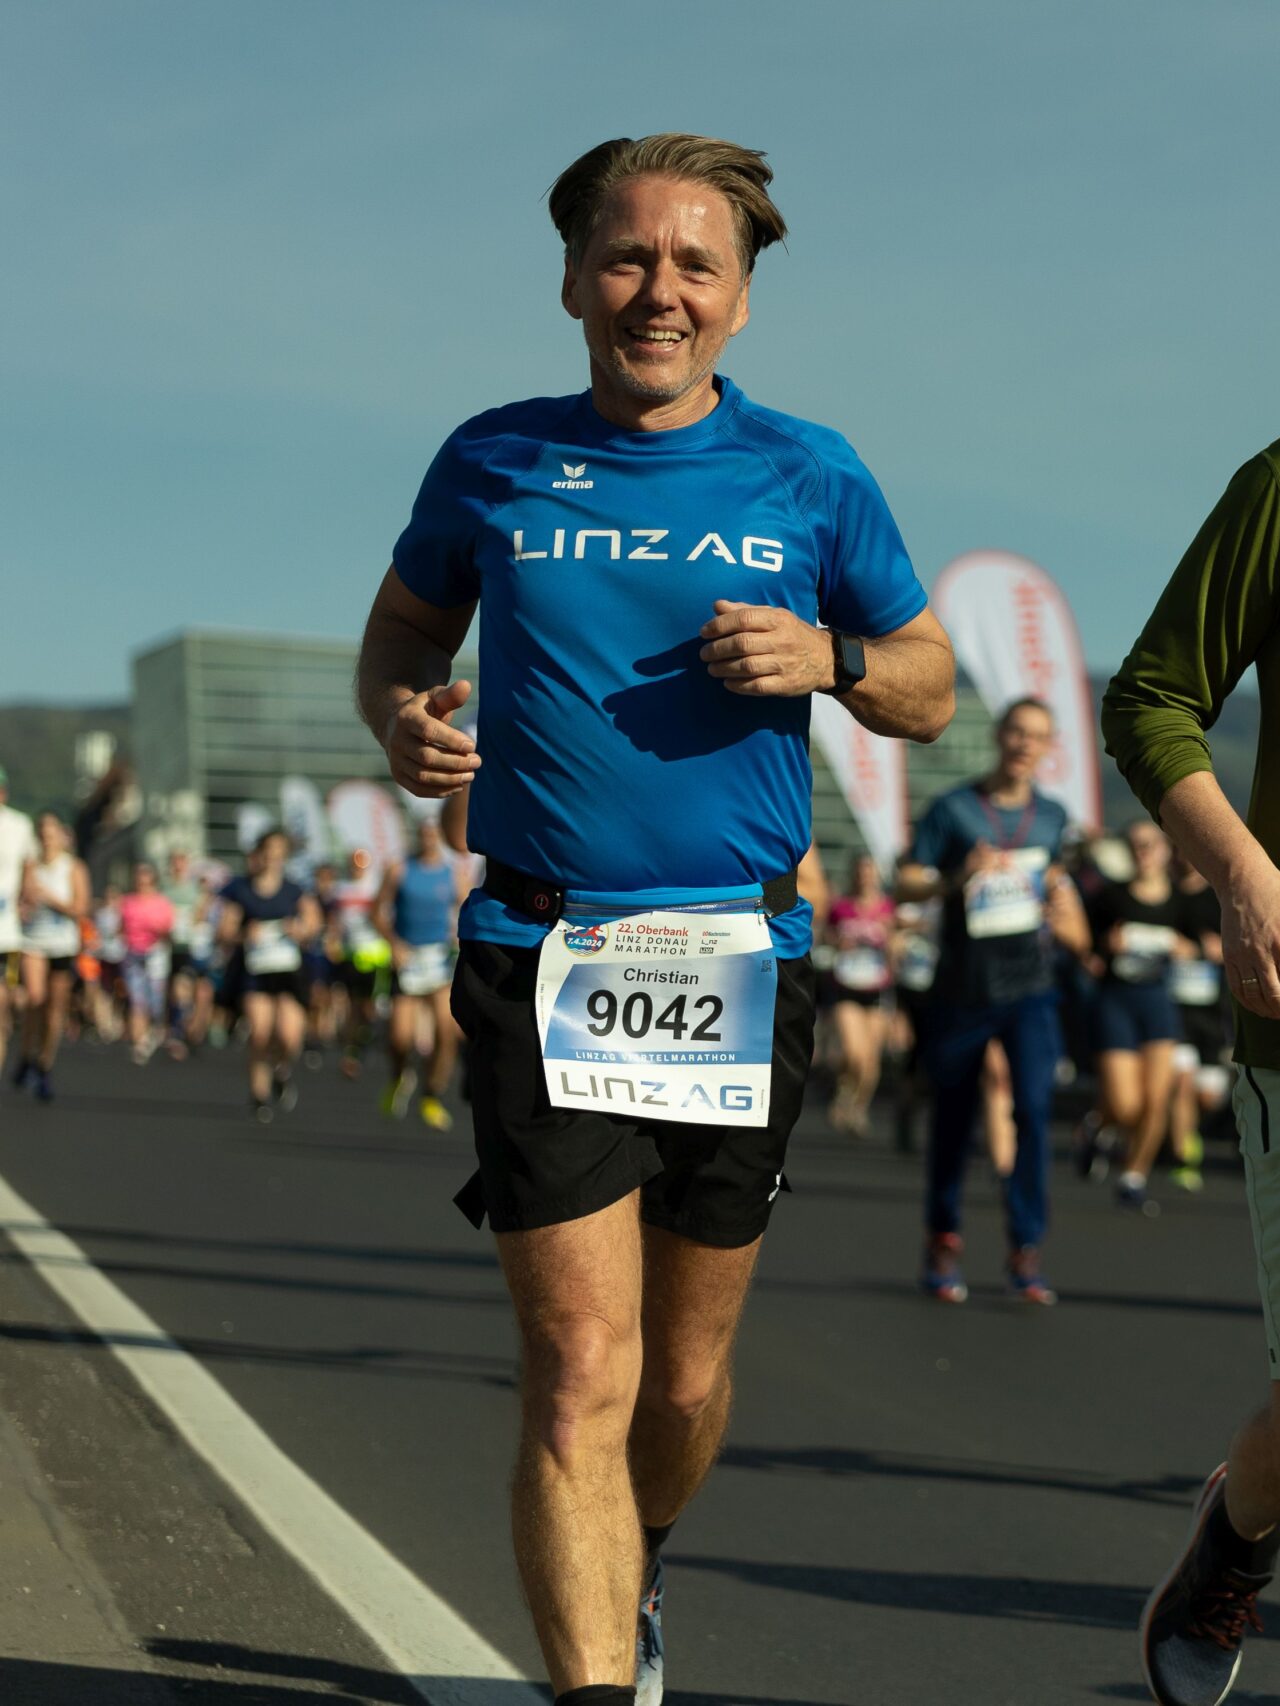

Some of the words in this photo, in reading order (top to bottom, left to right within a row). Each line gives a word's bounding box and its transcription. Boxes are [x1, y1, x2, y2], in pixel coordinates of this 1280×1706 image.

[552, 479, 593, 489] erima
[513, 529, 669, 561] LINZ
[686, 532, 784, 572] AG
[617, 923, 634, 934] 22.
[636, 924, 689, 937] Oberbank
[567, 937, 602, 948] 7.4.2024
[616, 934, 641, 945] LINZ
[647, 937, 688, 946] DONAU
[614, 945, 687, 956] MARATHON
[623, 967, 699, 986] Christian
[586, 989, 724, 1042] 9042
[575, 1051, 616, 1061] LINZAG
[622, 1052, 736, 1062] VIRTELMARATHON
[560, 1071, 669, 1107] LINZ
[680, 1083, 753, 1111] AG
